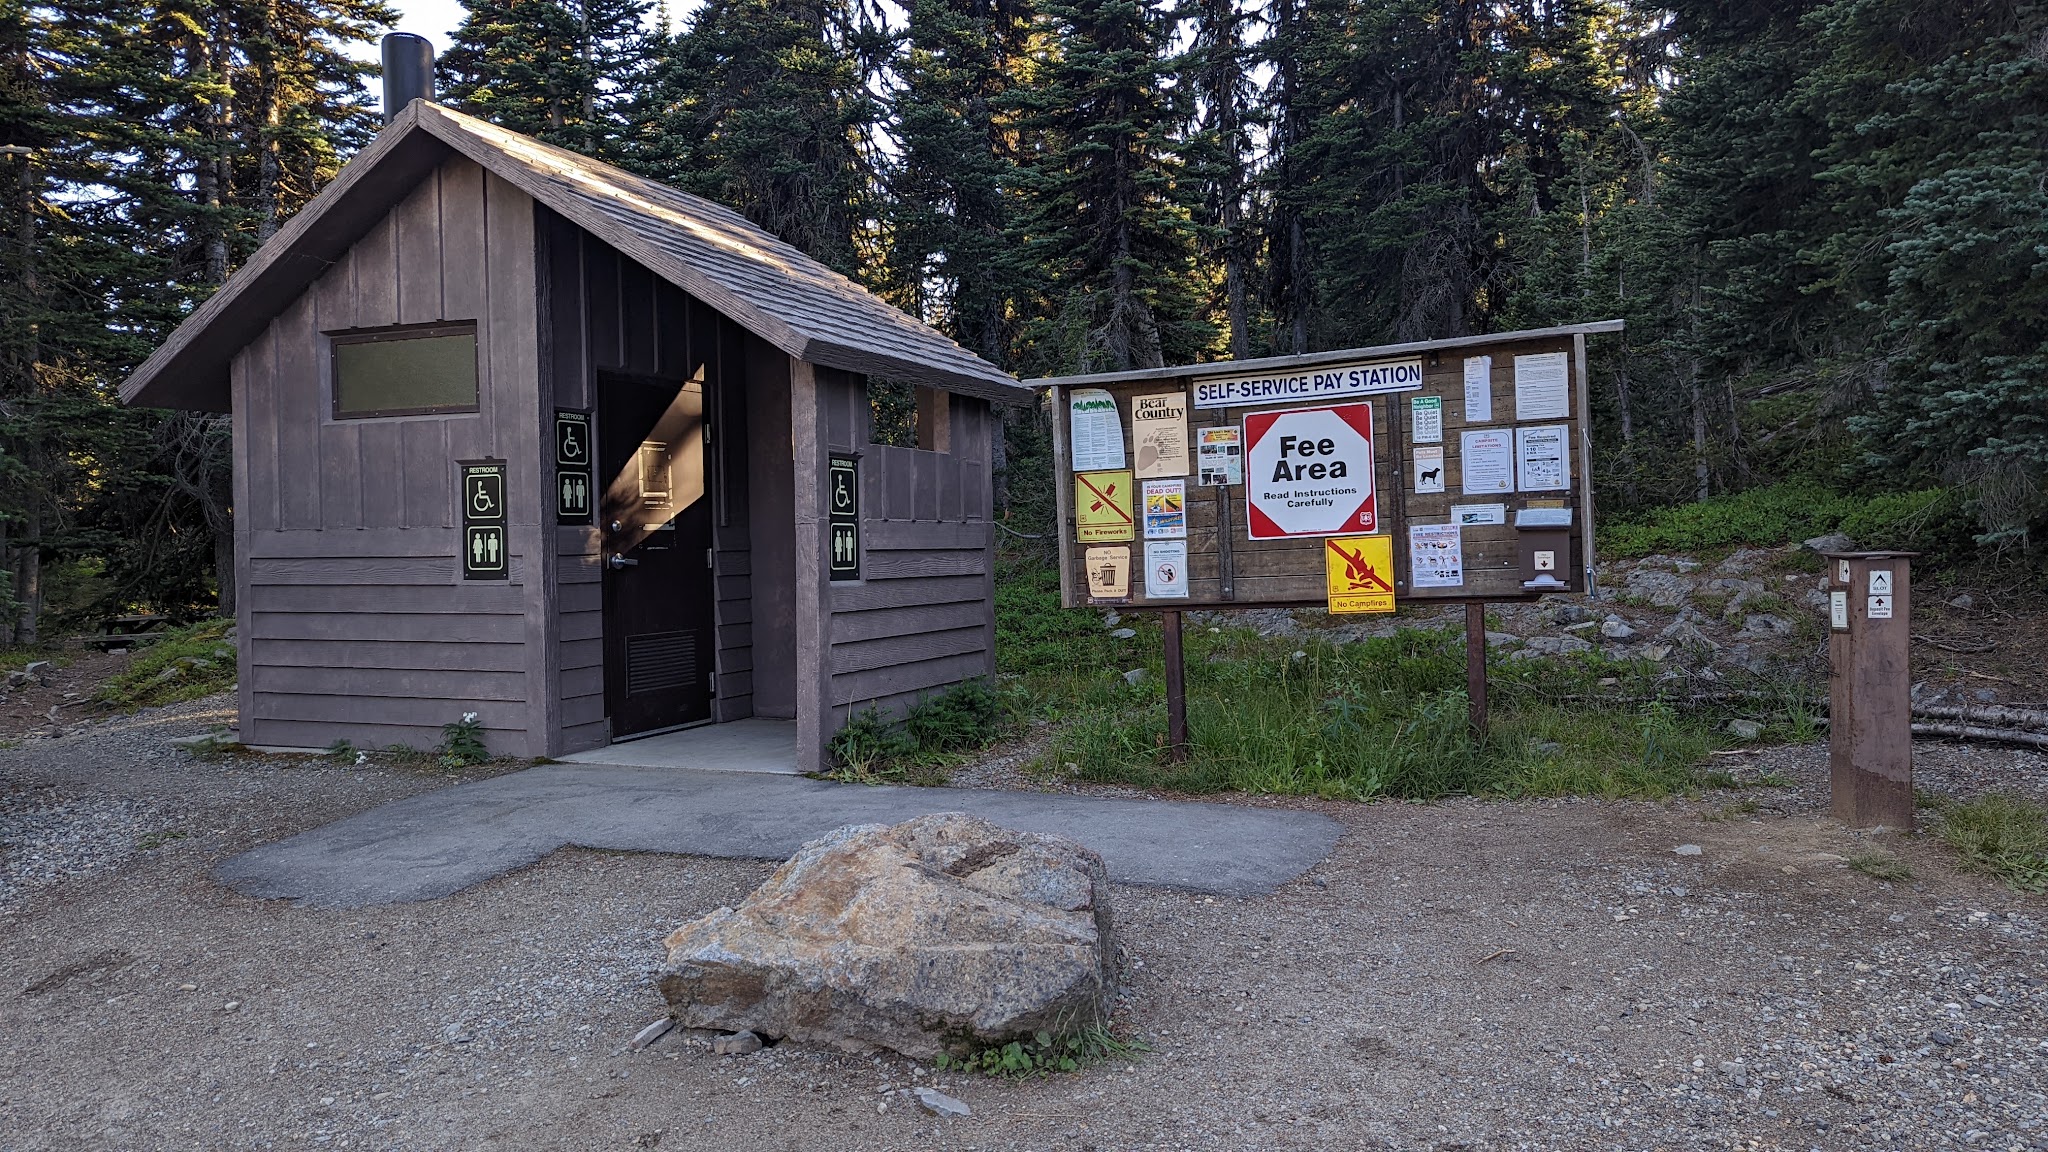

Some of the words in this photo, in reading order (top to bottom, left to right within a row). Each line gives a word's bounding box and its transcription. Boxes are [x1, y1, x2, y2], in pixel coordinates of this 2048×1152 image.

[1199, 376, 1309, 401] SELF-SERVICE
[1313, 372, 1344, 391] PAY
[1349, 364, 1420, 388] STATION
[1140, 397, 1168, 409] Bear
[559, 412, 585, 421] RESTROOM
[1135, 407, 1184, 421] Country
[1280, 435, 1335, 459] Fee
[831, 459, 853, 468] RESTROOM
[1271, 459, 1348, 483] Area
[1263, 491, 1290, 500] Read
[1294, 487, 1357, 498] Instructions
[1287, 498, 1334, 508] Carefully
[1349, 600, 1387, 608] Campfires
